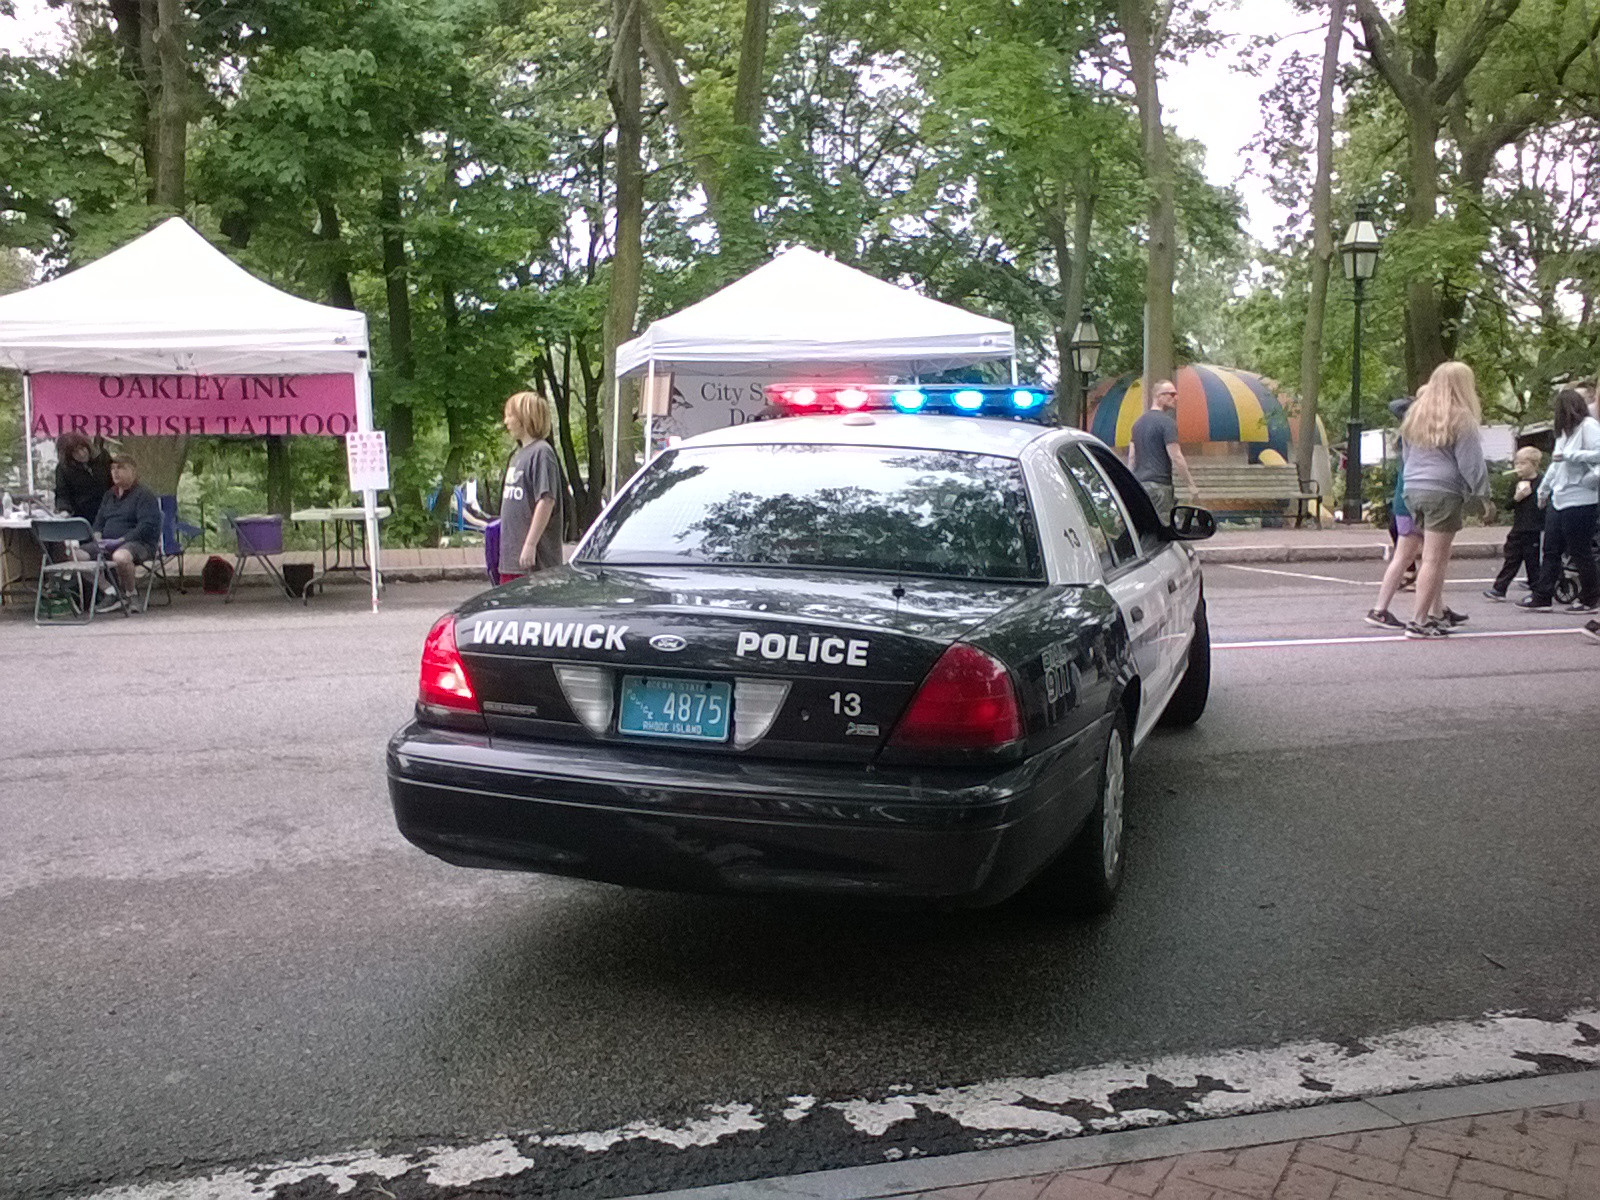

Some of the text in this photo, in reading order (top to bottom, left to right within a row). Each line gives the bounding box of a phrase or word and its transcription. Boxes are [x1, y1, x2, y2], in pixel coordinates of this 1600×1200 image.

[99, 375, 299, 400] OAKLEY INK
[701, 382, 744, 406] City
[31, 412, 357, 438] AIRBRUSH TATTOO
[1063, 527, 1081, 549] 13
[472, 620, 630, 651] WARWICK
[735, 631, 870, 667] POLICE
[662, 691, 723, 725] 4875
[829, 691, 862, 717] 13
[642, 720, 703, 735] RHODE ISLAND
